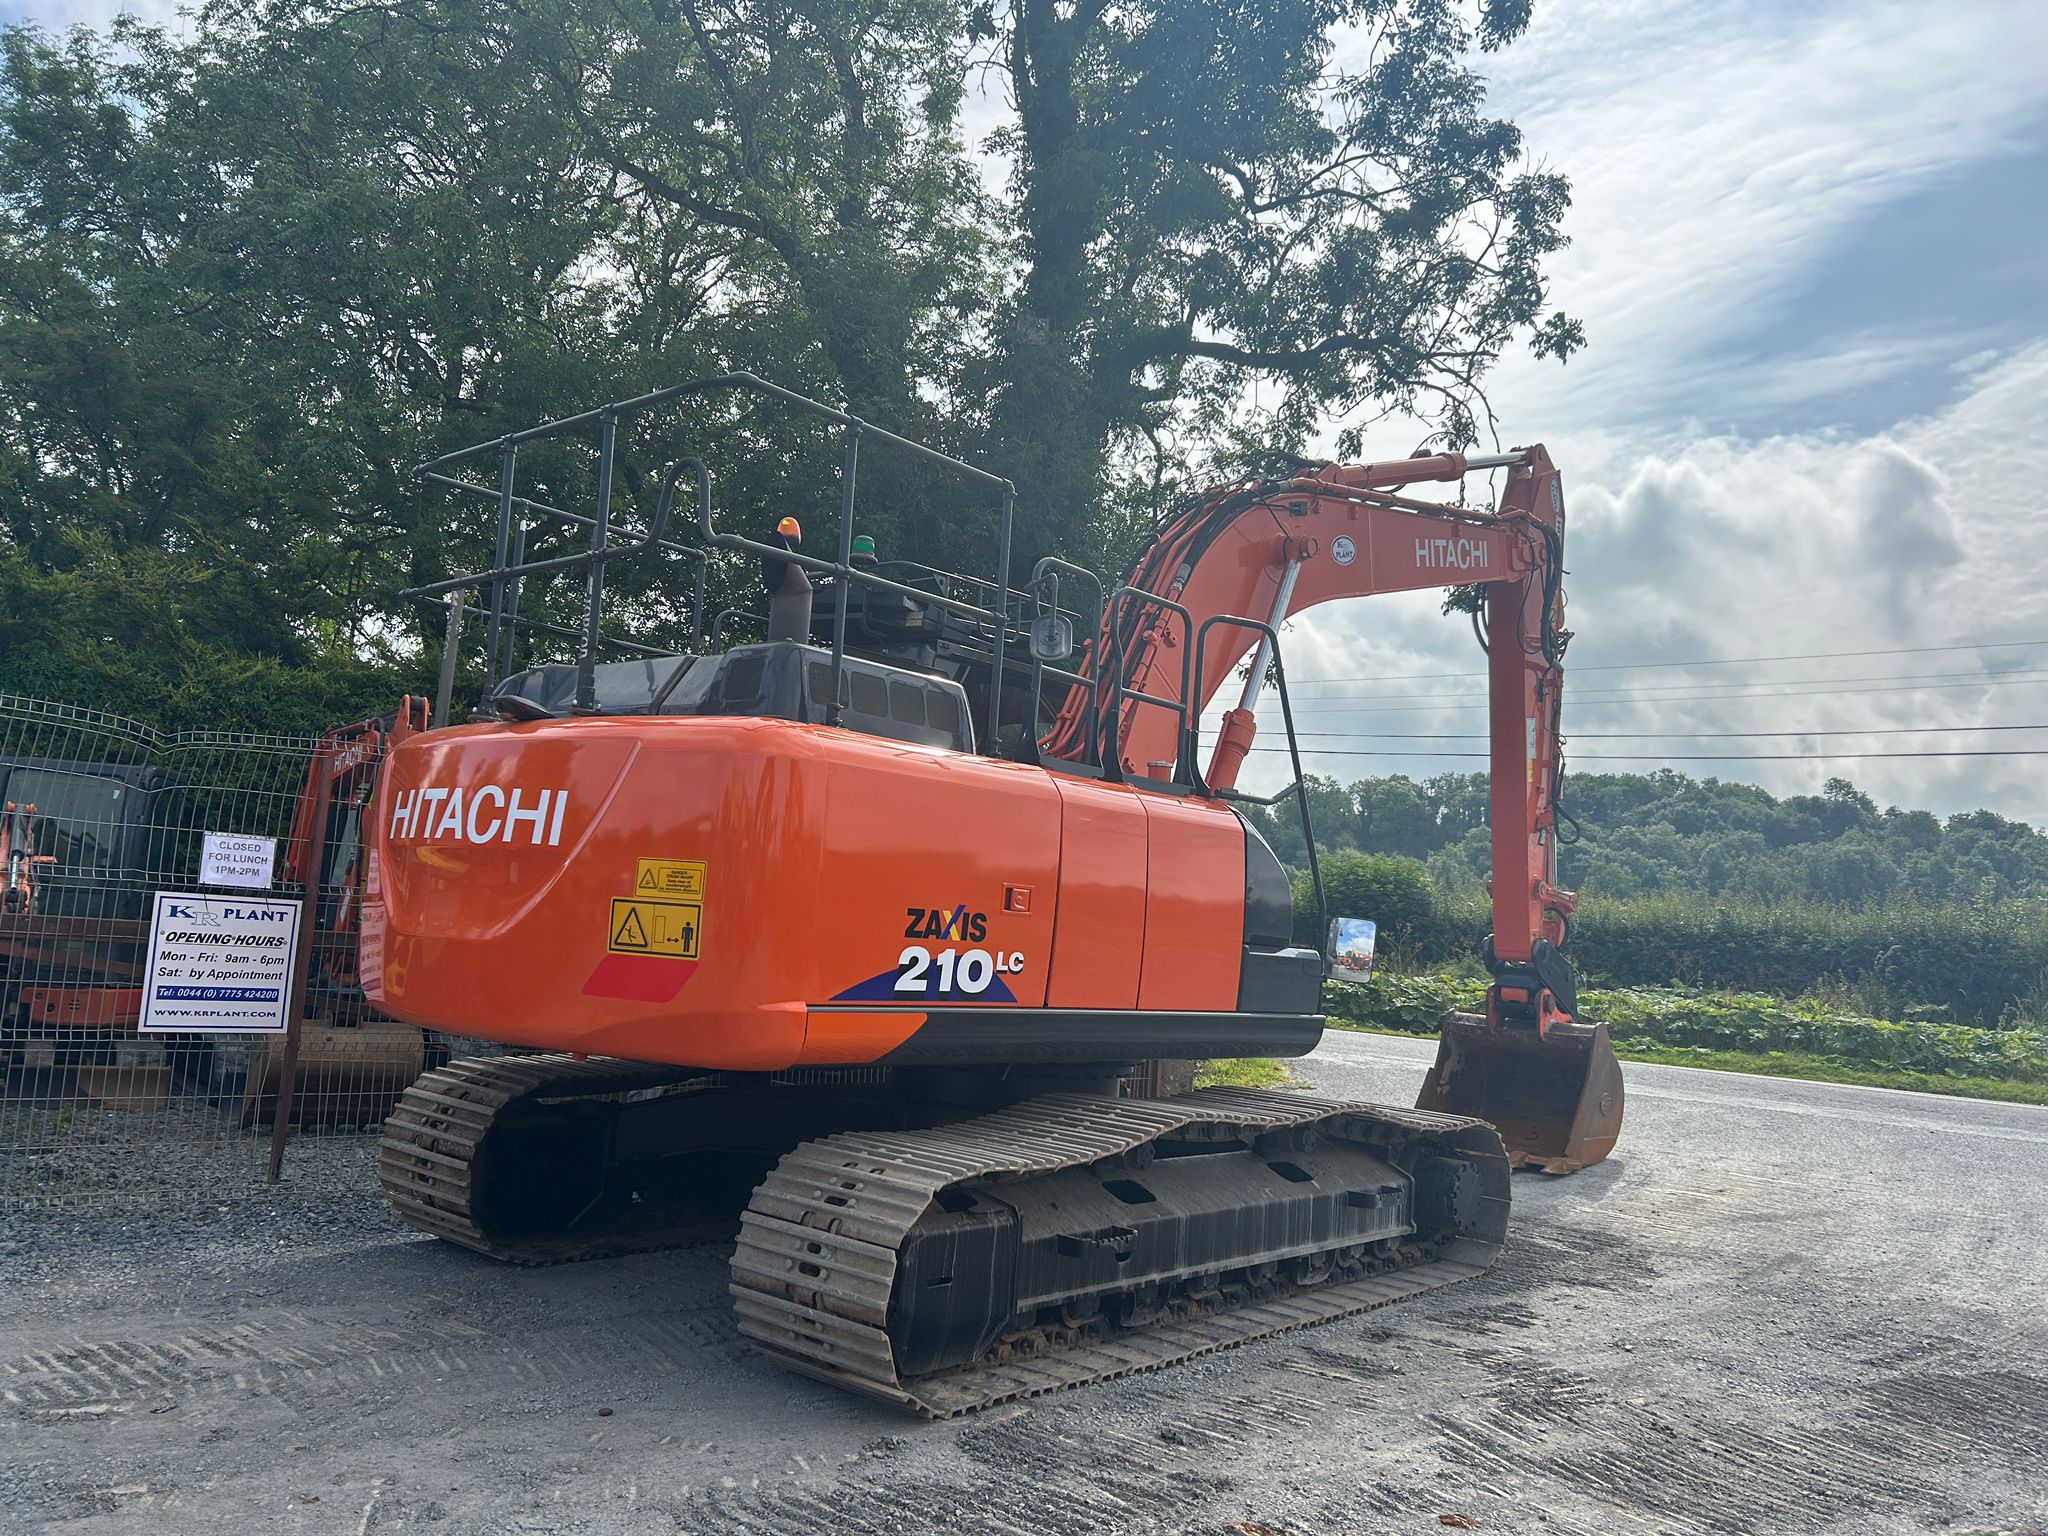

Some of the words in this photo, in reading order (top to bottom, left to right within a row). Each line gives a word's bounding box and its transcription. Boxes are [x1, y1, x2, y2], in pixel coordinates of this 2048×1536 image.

[1335, 550, 1353, 559] PLANT
[1415, 538, 1488, 570] HITACHI
[389, 784, 569, 846] HITACHI
[219, 841, 261, 853] CLOSED
[208, 852, 231, 862] FOR
[233, 854, 268, 865] LUNCH
[215, 865, 260, 877] 1PM-2PM
[223, 908, 288, 922] PLANT
[904, 904, 987, 942] ZAXIS
[165, 931, 232, 945] OPENING
[234, 935, 285, 947] HOURS
[160, 951, 187, 961] Mon
[197, 952, 218, 962] Fri:
[225, 953, 249, 964] 9am
[260, 955, 285, 966] 6pm
[158, 967, 182, 977] Sat:
[189, 968, 205, 979] by
[207, 968, 283, 980] Appointment
[893, 945, 994, 994] 210
[996, 951, 1025, 973] LC
[158, 988, 174, 997] Tel:
[177, 988, 202, 997] 0044
[203, 989, 217, 998] (0)
[219, 989, 242, 998] 7775
[243, 990, 278, 999] 424200
[154, 1009, 276, 1018] WWW.KRPLANT.COM
